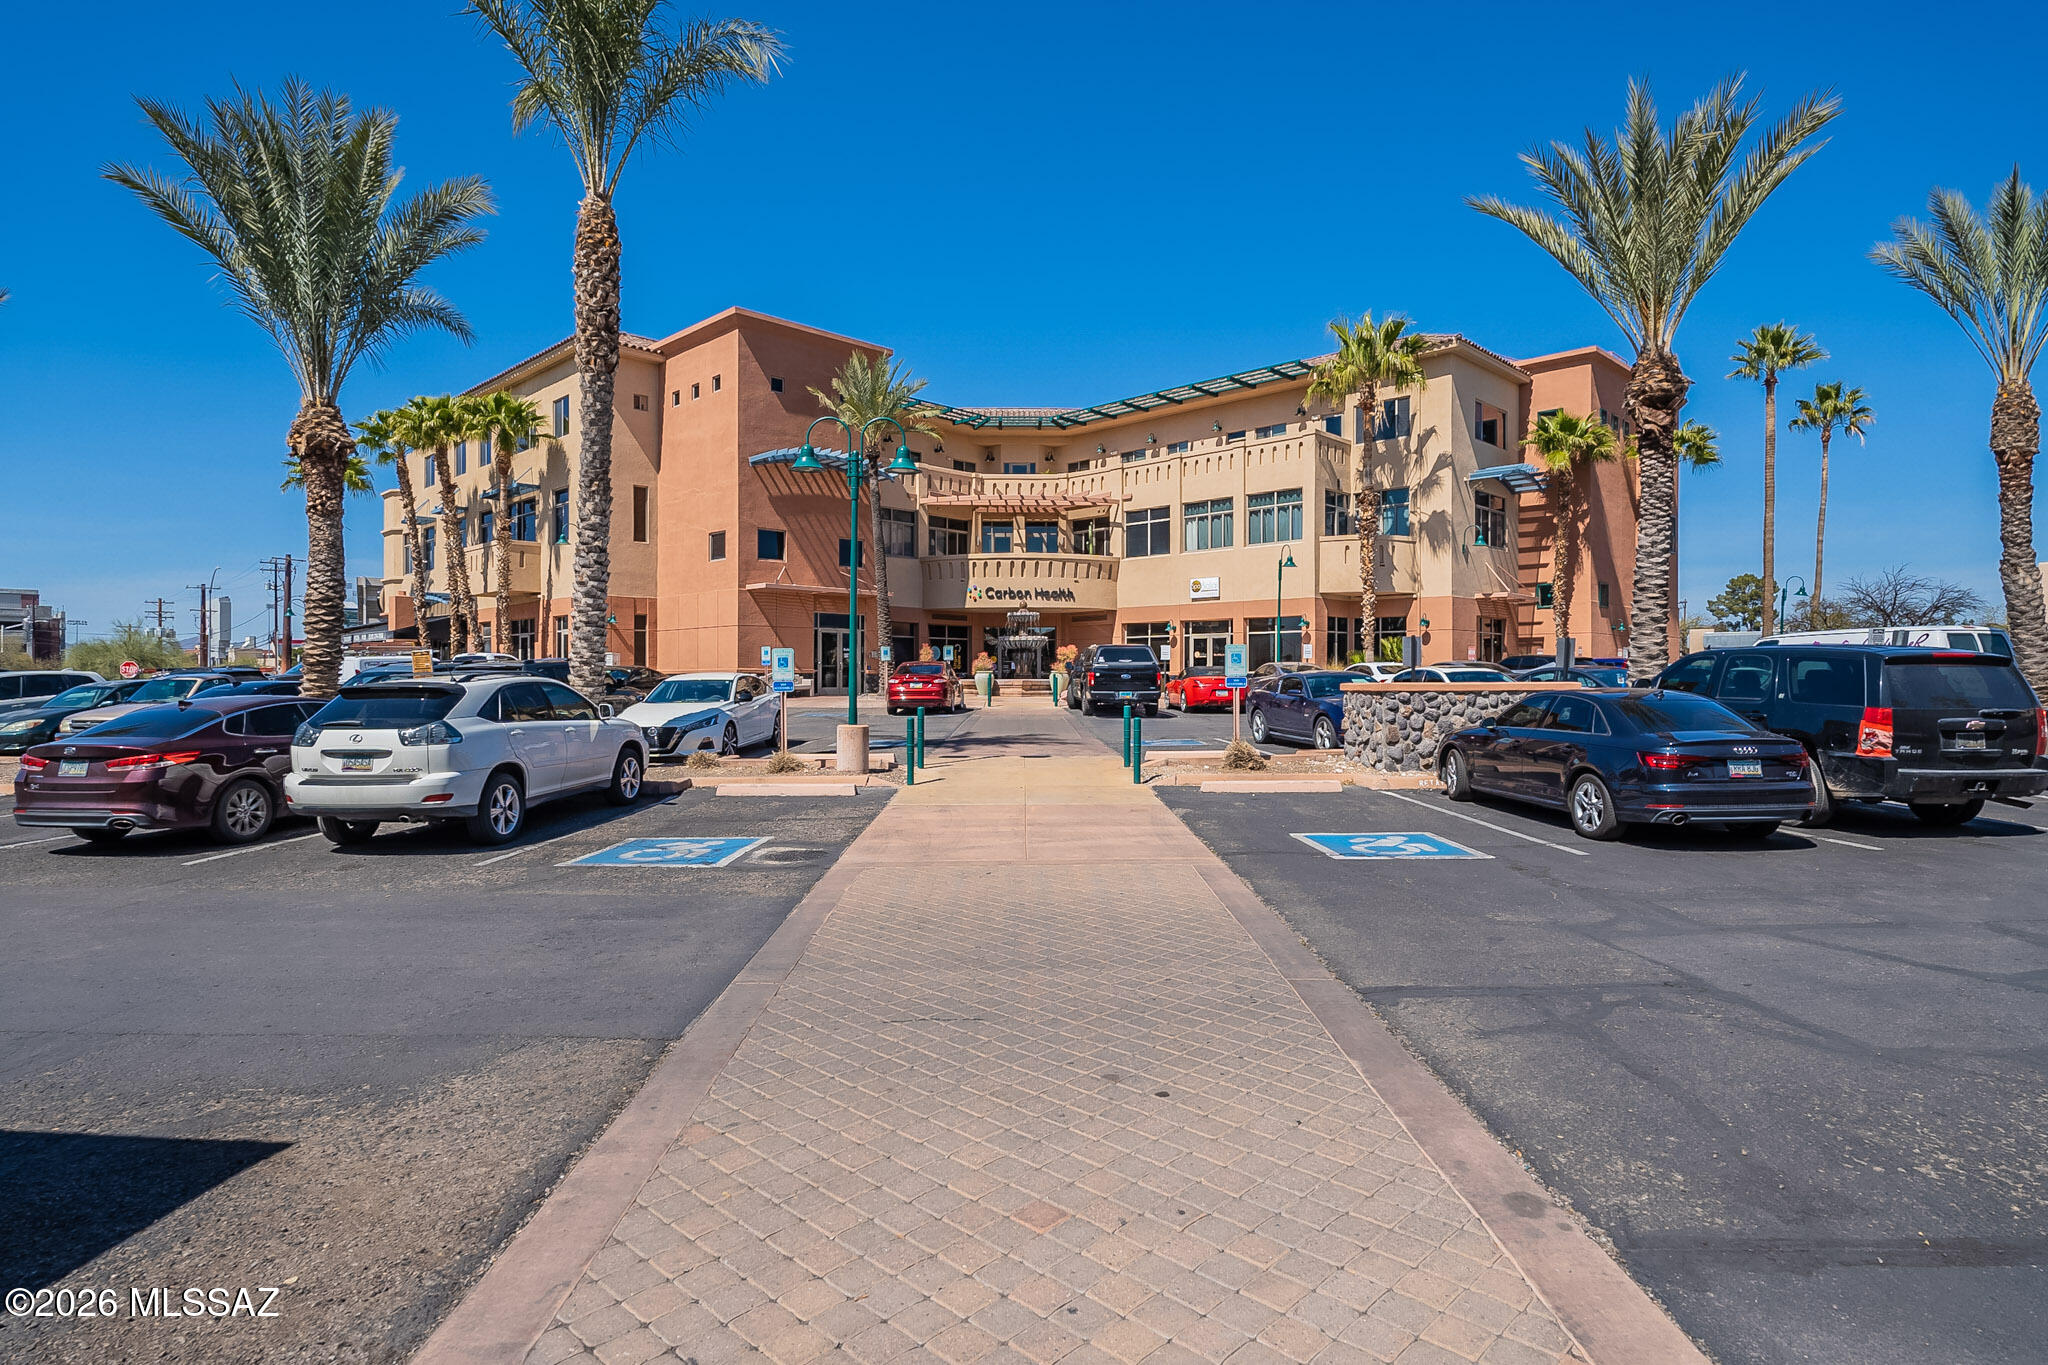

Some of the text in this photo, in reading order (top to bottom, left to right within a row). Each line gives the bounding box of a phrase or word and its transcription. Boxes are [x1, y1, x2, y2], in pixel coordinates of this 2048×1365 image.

[985, 586, 1075, 603] Carbon Health
[121, 665, 138, 673] STOP
